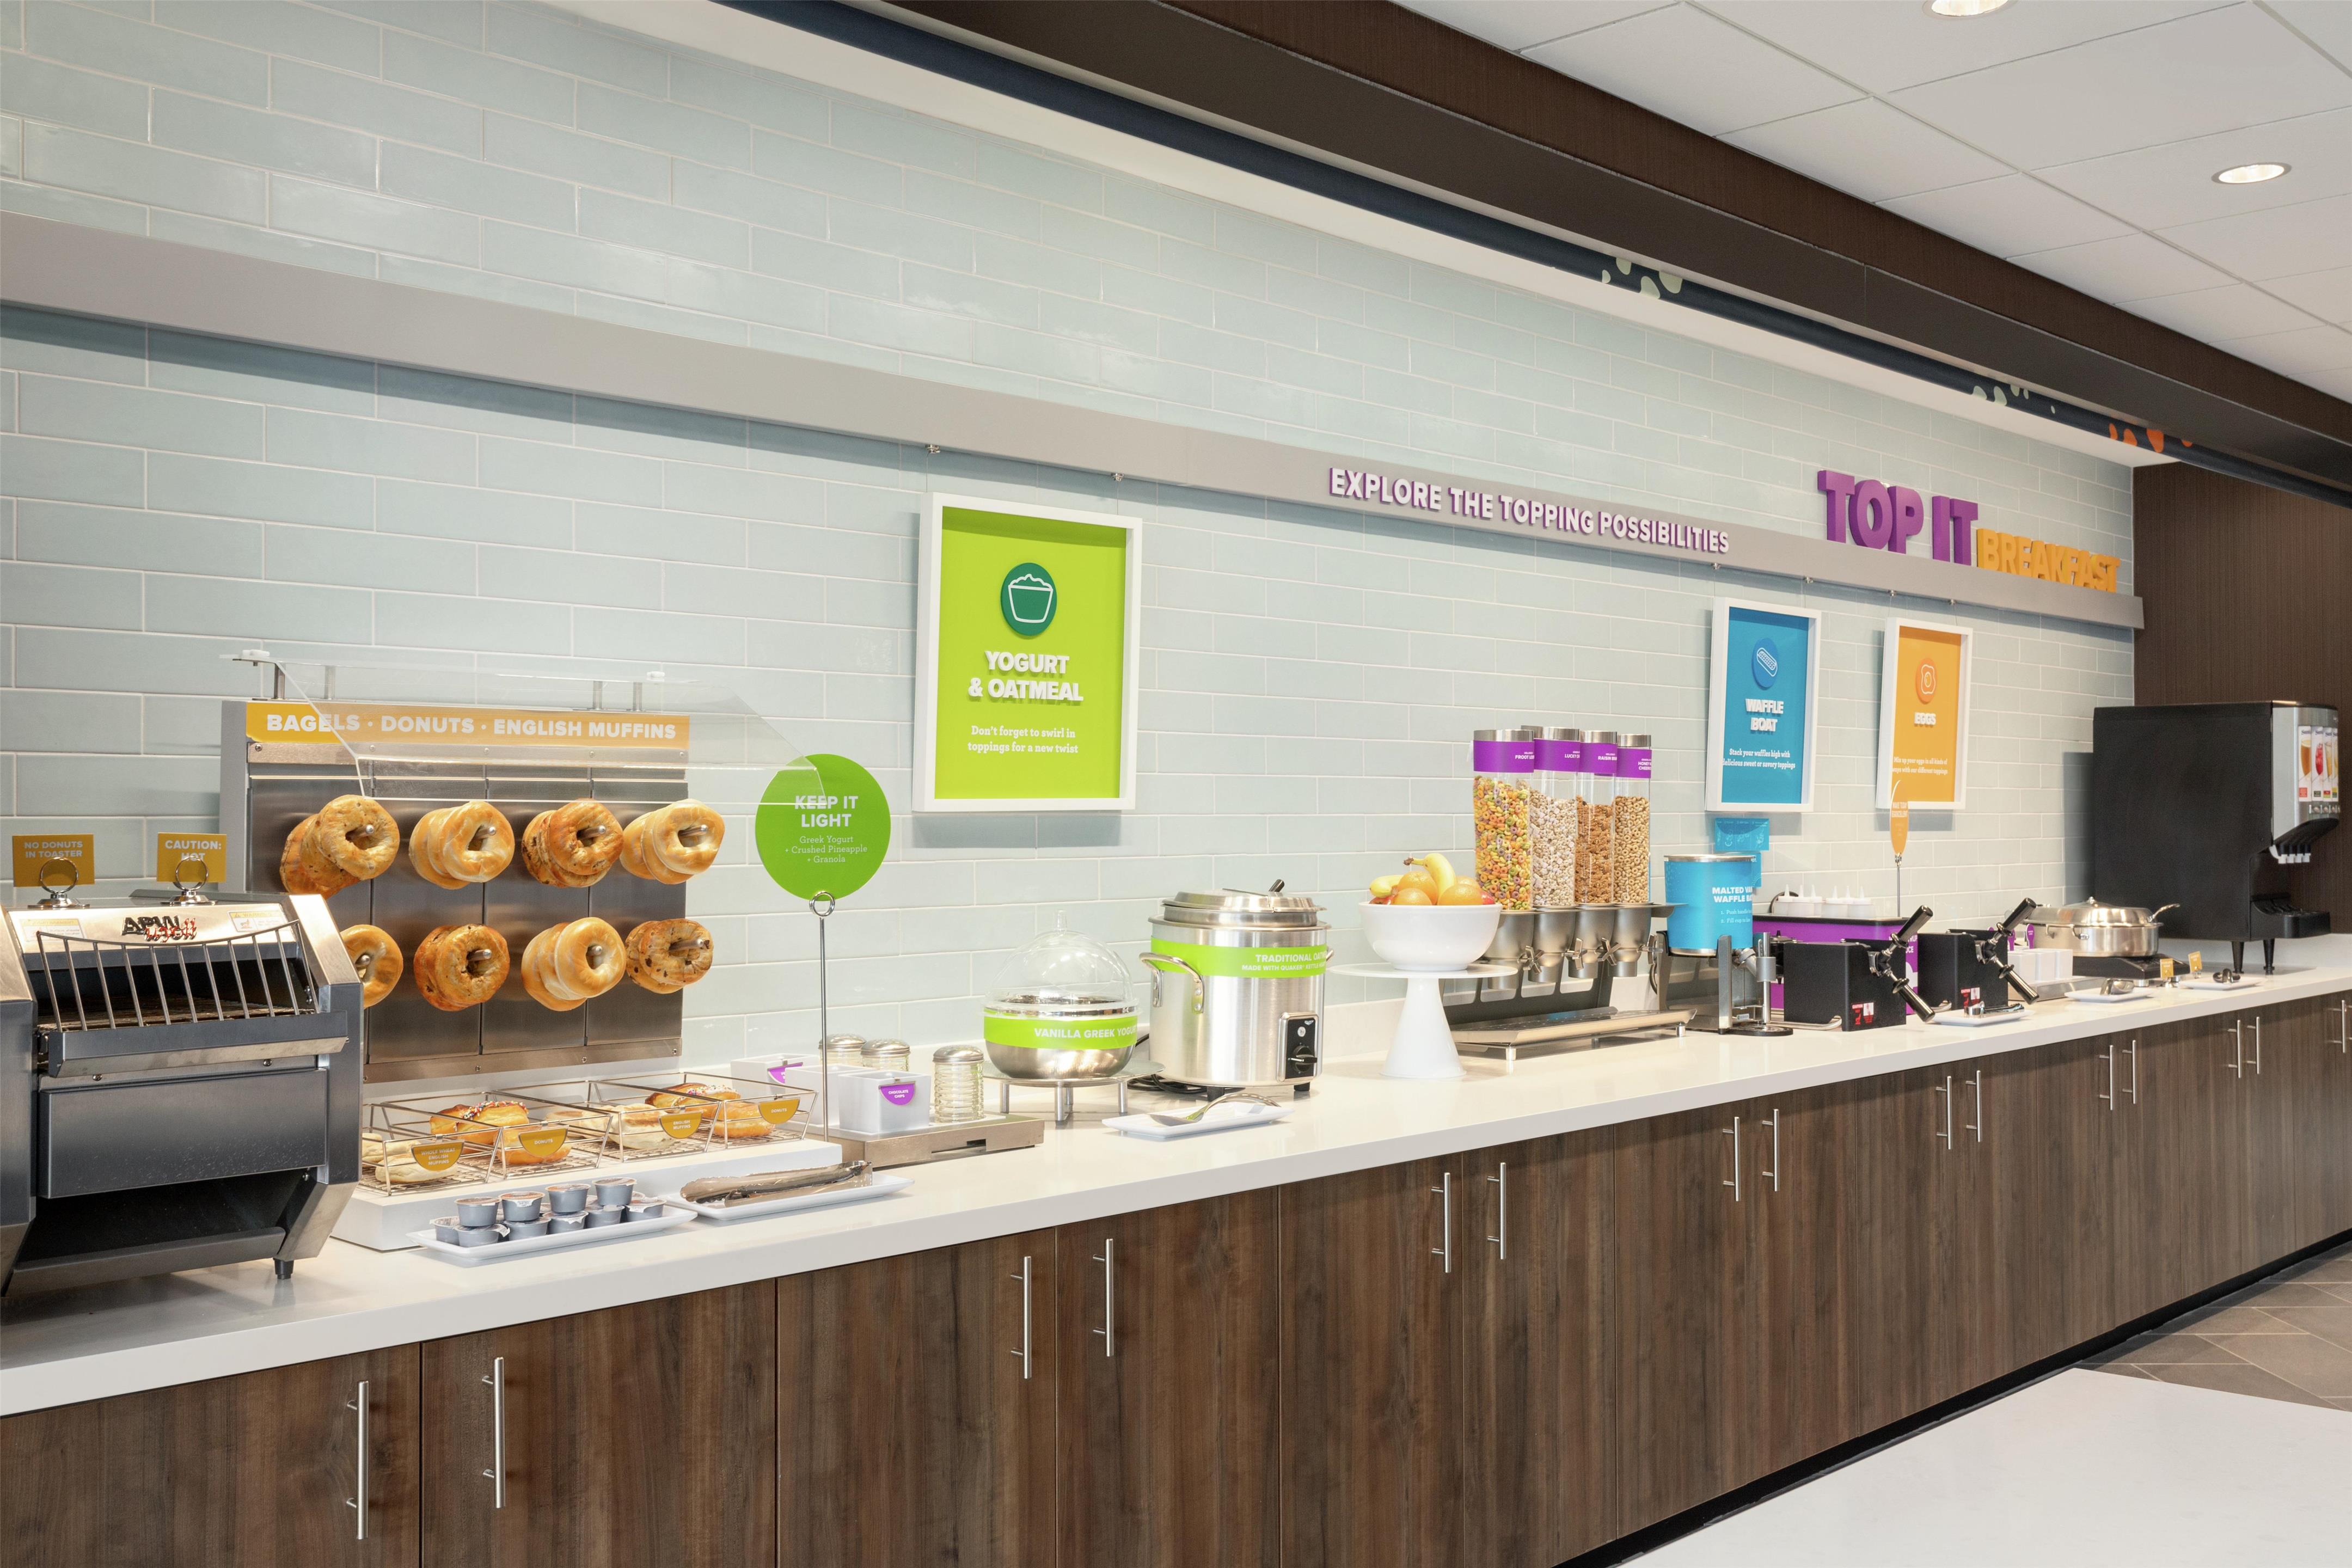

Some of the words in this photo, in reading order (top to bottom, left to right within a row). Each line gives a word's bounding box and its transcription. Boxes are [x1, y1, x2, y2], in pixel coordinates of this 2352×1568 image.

[1330, 468, 1442, 510] EXPLORE
[1449, 487, 1493, 519] THE
[1498, 494, 1594, 534] TOPPING
[1598, 511, 1729, 553] POSSIBILITIES
[1817, 470, 1924, 554] TOP
[1932, 495, 1979, 566] IT
[1976, 528, 2121, 593] BREAKFAST
[985, 651, 1070, 674] YOGURT
[968, 677, 983, 697] &
[988, 678, 1083, 701] OATMEAL
[1745, 699, 1784, 714] WAFFLE
[1750, 717, 1778, 732] BOAT
[1914, 712, 1936, 725] EGGS
[266, 714, 360, 733] BAGELS
[381, 716, 475, 734] DONUTS
[493, 719, 582, 737] ENGLISH
[589, 721, 676, 739] MUFFINS
[1000, 725, 1028, 739] forget
[1030, 728, 1039, 737] to
[1042, 727, 1064, 738] swirl
[1066, 728, 1075, 738] in
[968, 741, 1010, 754] toppings
[1012, 741, 1025, 752] for
[1055, 744, 1079, 753] twist
[1754, 749, 1771, 757] waffles
[1771, 750, 1780, 759] high
[1778, 761, 1796, 770] toppings
[795, 795, 838, 809] KEEP
[844, 796, 859, 809] IT
[801, 813, 852, 828] LIGHT
[165, 840, 222, 850] CAUTION:
[799, 835, 824, 843] Greek
[826, 835, 854, 844] Yogurt
[792, 845, 825, 854] Crushed
[828, 844, 867, 854] Pineapple
[181, 853, 205, 862] HOT
[813, 854, 846, 863] Granola
[1255, 954, 1312, 963] TRADITIONAL
[1034, 1028, 1081, 1038] VANILLA
[1084, 1029, 1115, 1038] GREEK
